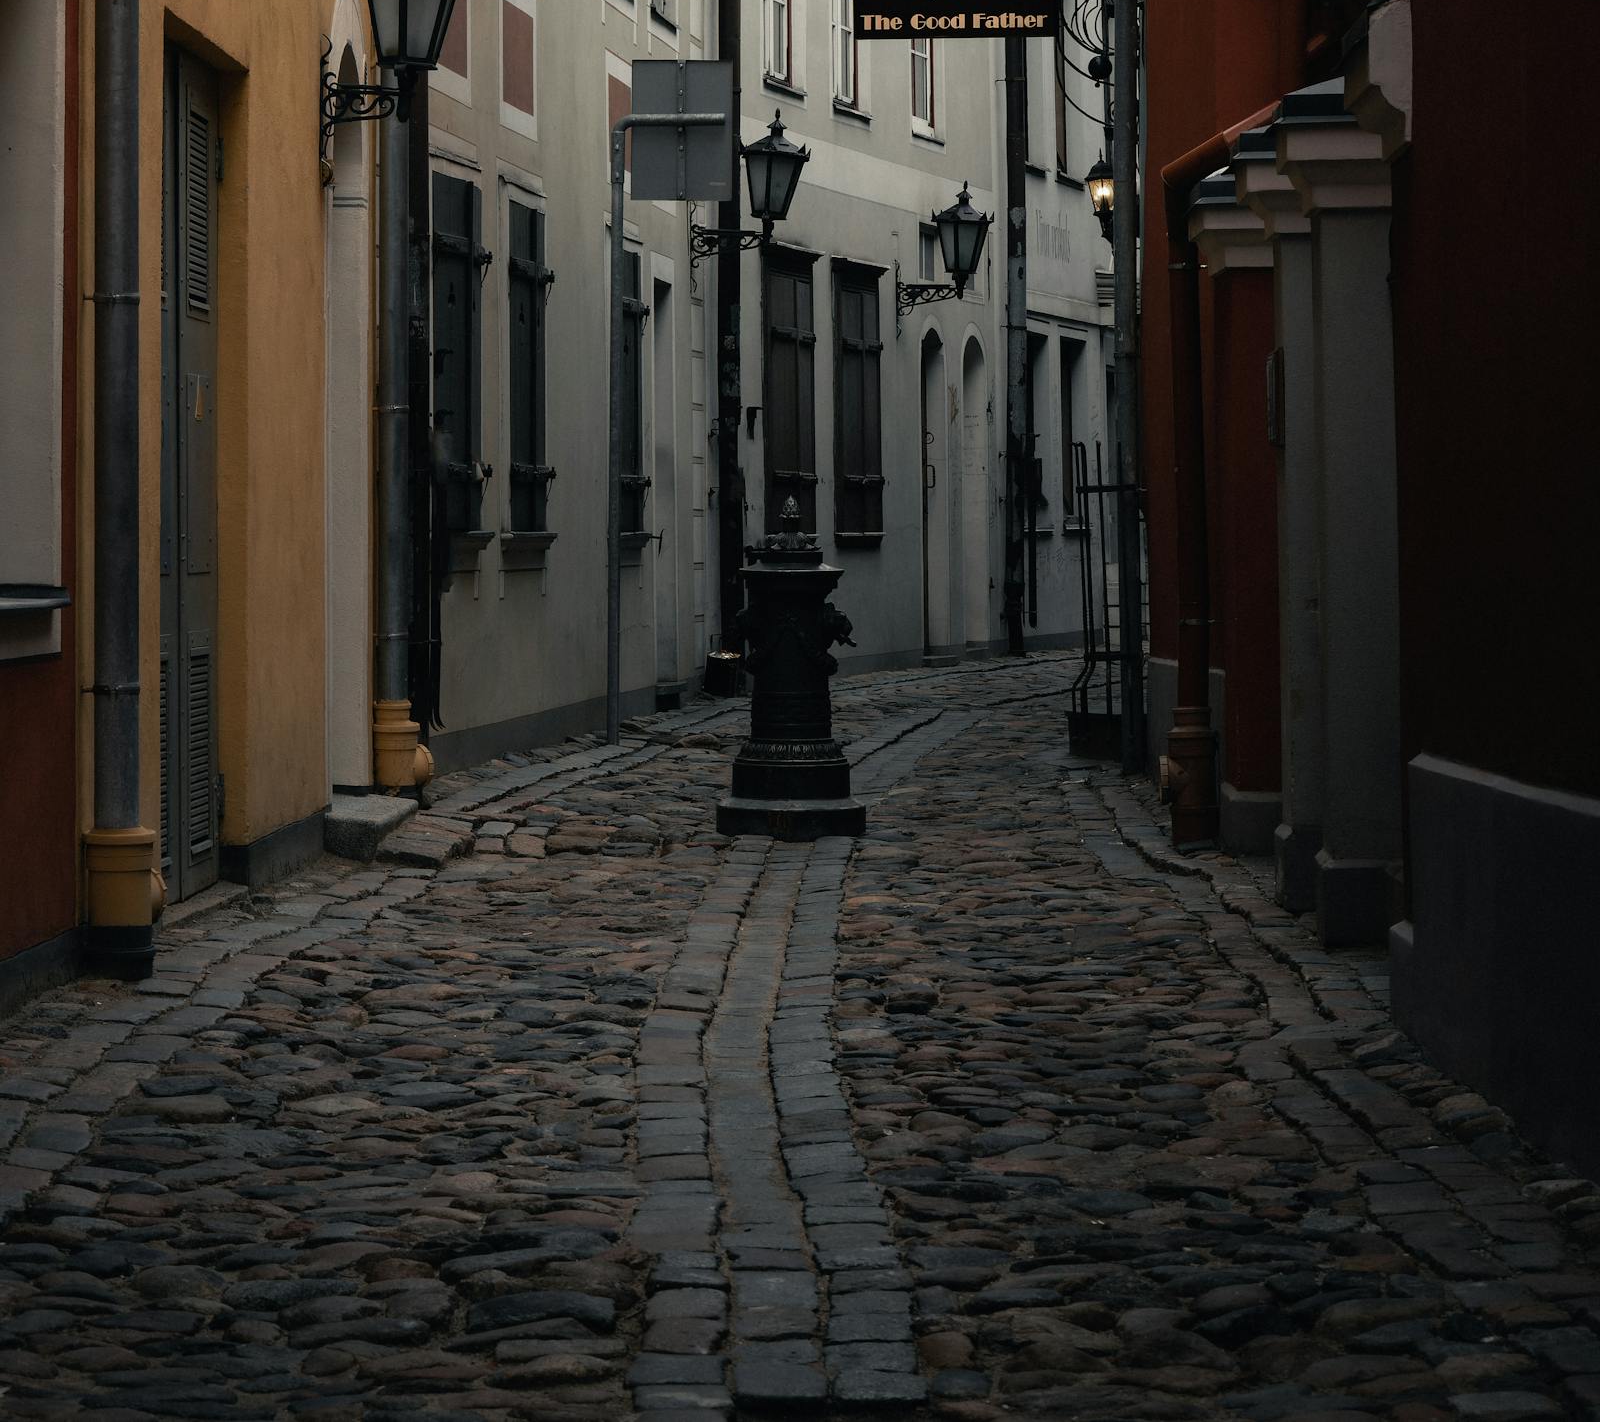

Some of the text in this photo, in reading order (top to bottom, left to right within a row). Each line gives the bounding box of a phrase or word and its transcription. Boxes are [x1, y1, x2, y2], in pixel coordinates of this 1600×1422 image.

[860, 12, 1048, 31] The Good Father
